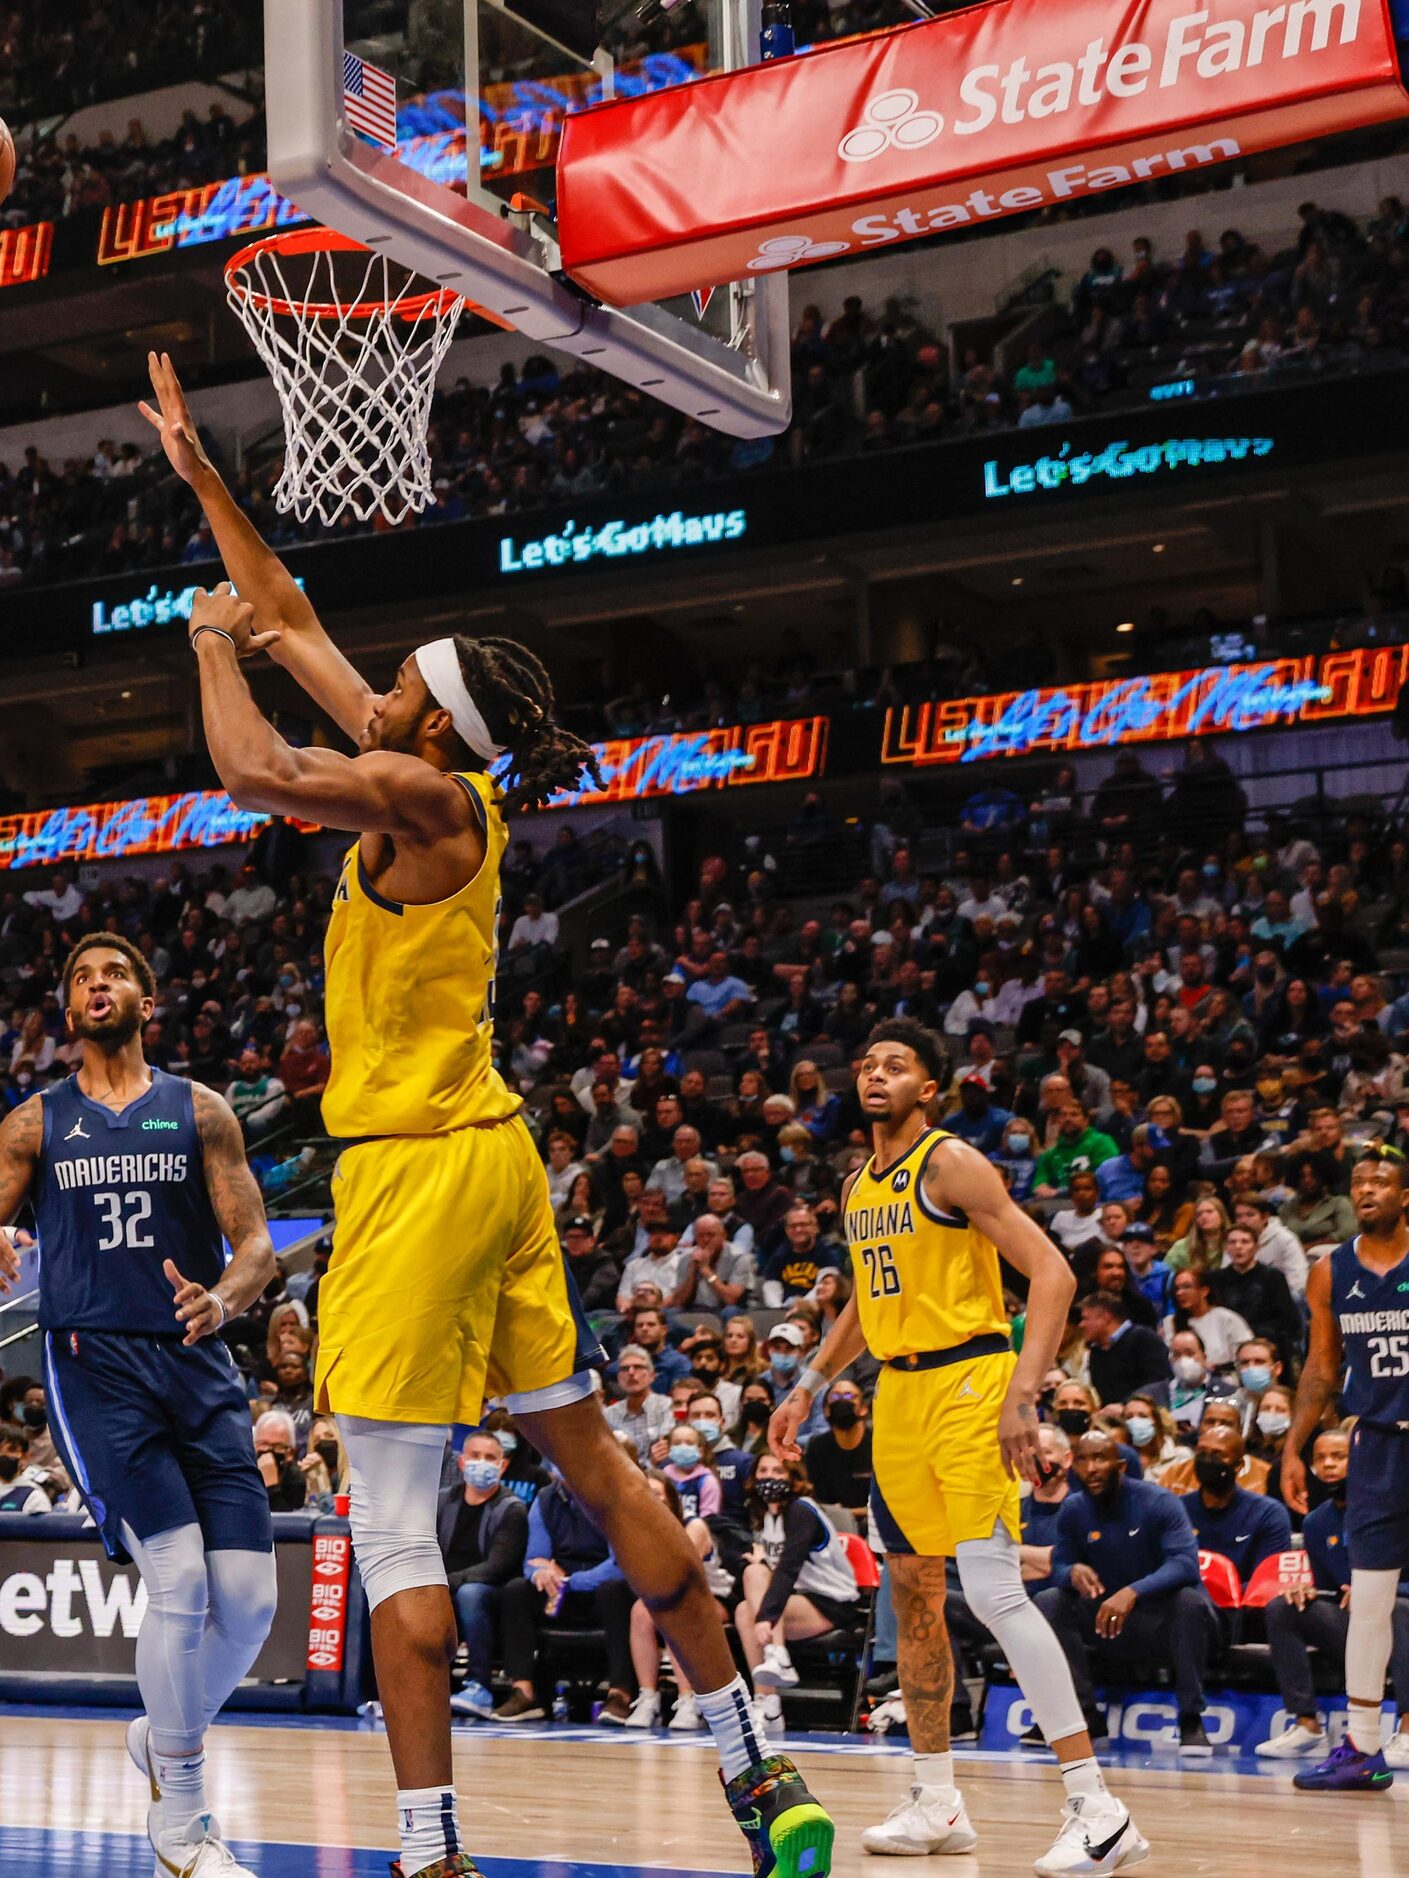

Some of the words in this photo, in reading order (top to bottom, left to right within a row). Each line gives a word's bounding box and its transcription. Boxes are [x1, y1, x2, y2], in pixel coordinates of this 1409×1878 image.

[953, 37, 1153, 136] State
[1158, 0, 1362, 88] Farm
[851, 186, 1044, 246] State
[1045, 138, 1241, 200] Farm
[501, 520, 593, 571] Let's
[142, 1118, 179, 1131] chime
[54, 1153, 188, 1190] MAVERICKS
[94, 1190, 155, 1250] 32
[844, 1201, 915, 1244] INDIANA
[862, 1244, 903, 1299] 26
[1367, 1335, 1409, 1378] 25
[315, 1539, 347, 1554] BIO
[312, 1584, 343, 1599] BIO
[309, 1629, 340, 1644] BIO
